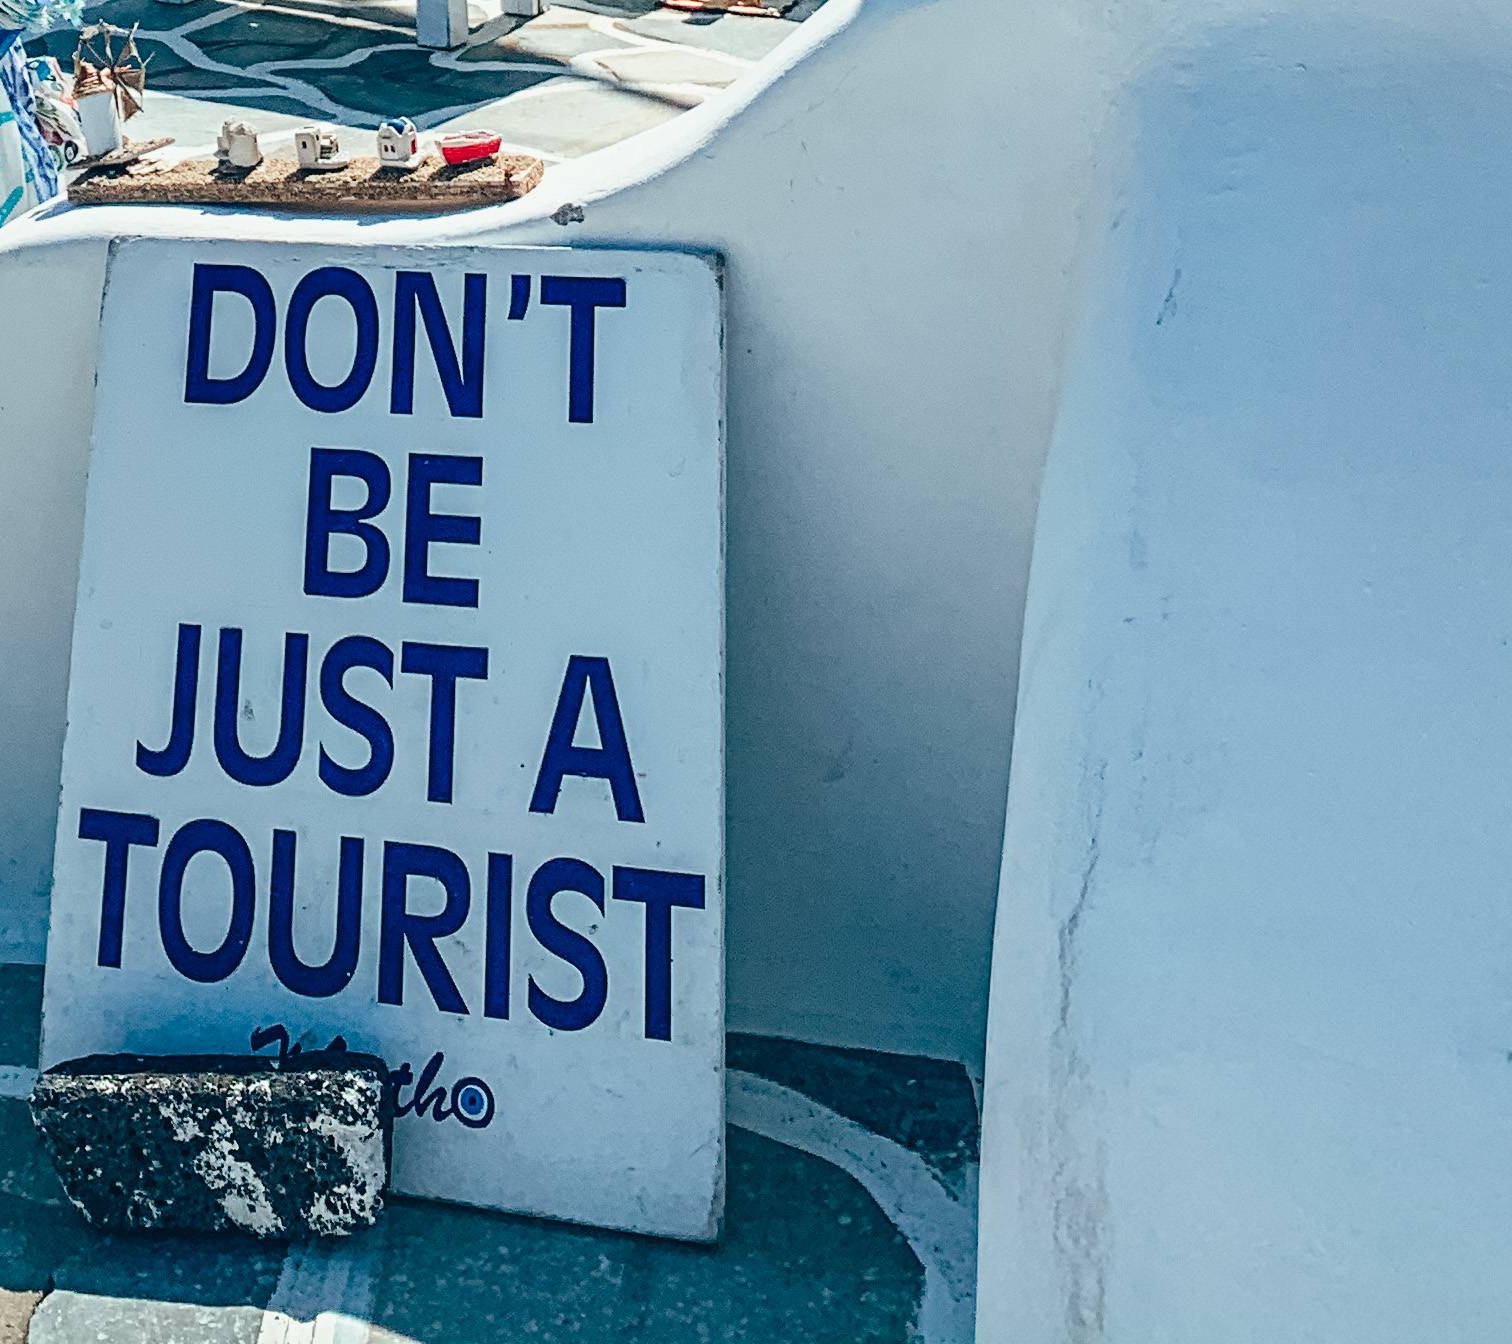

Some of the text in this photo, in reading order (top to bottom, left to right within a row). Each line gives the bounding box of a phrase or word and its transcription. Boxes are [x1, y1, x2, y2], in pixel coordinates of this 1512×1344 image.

[183, 262, 627, 424] DON'T
[302, 447, 485, 609] BE
[134, 622, 646, 824] JUST A
[77, 806, 706, 1042] TOURIST
